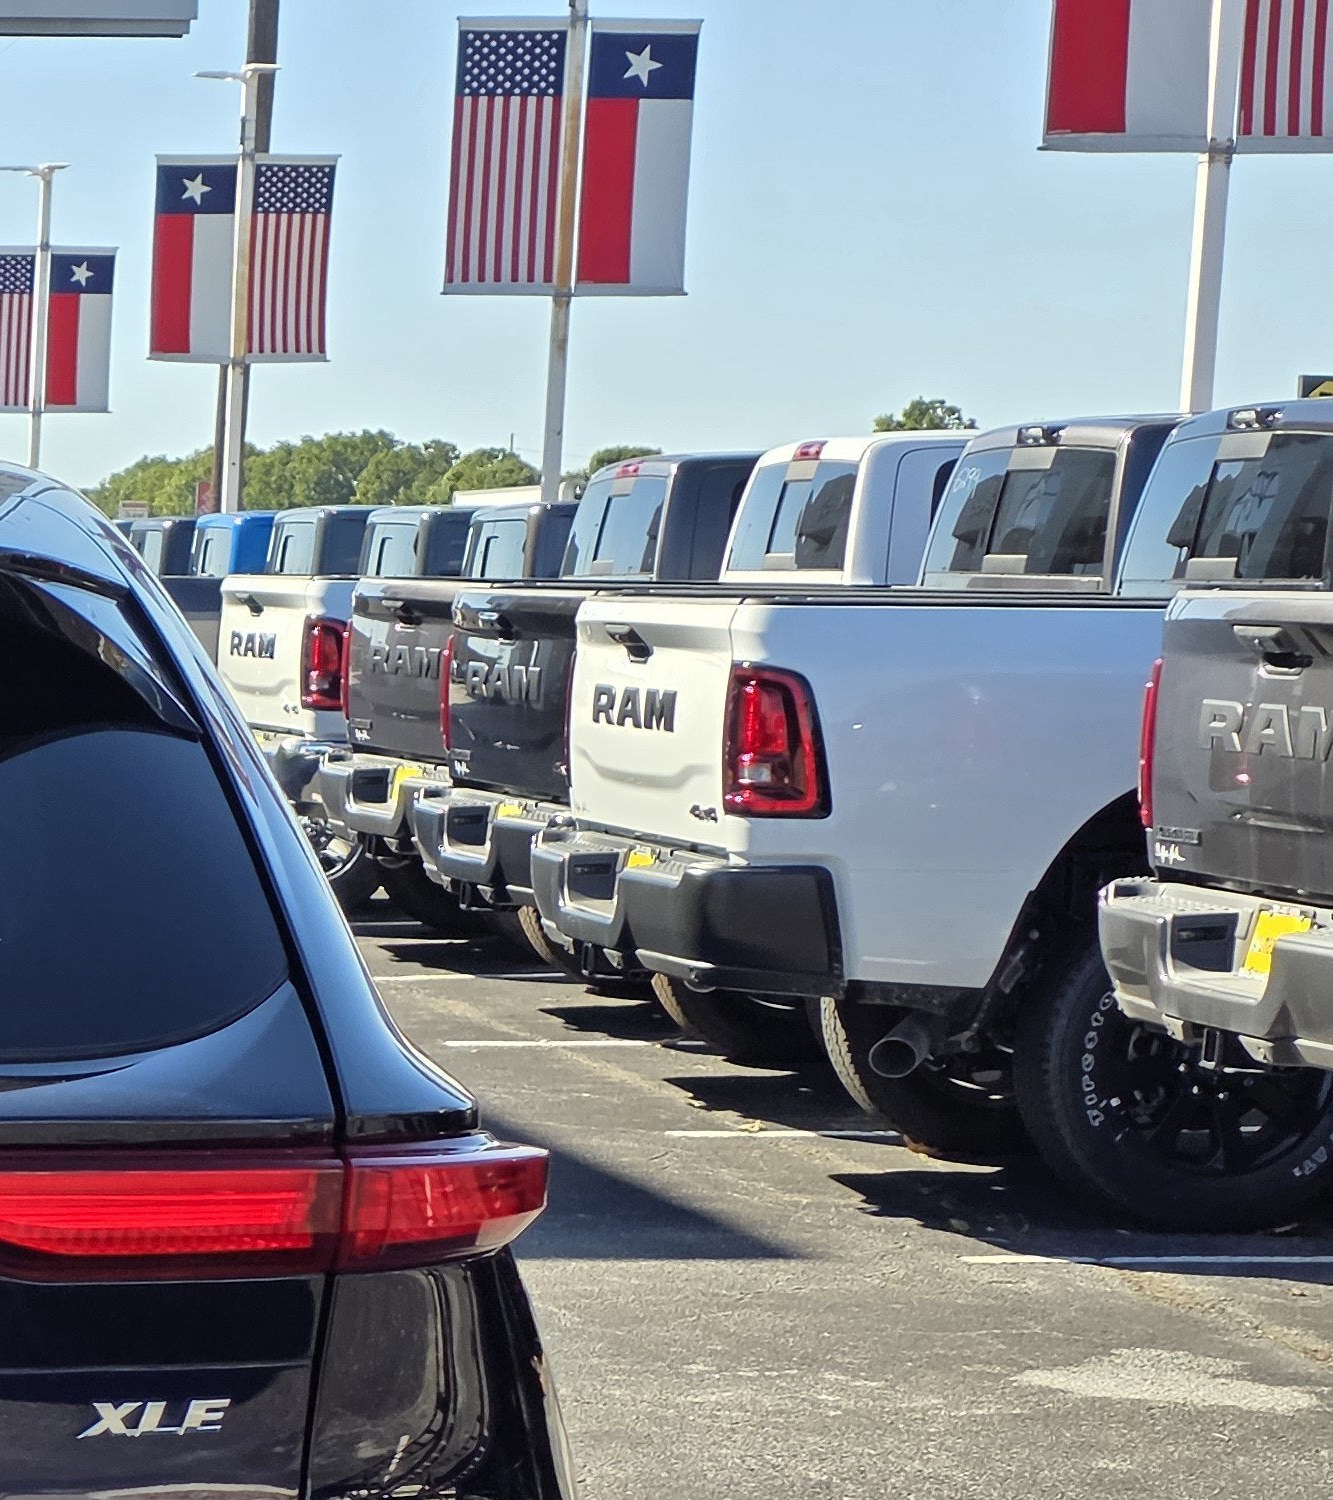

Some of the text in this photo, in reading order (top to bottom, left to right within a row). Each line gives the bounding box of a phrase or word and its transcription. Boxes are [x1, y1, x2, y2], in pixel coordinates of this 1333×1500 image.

[230, 630, 277, 660] RAM
[371, 644, 441, 680] RAM
[465, 660, 544, 708] RAM
[591, 683, 678, 733] RAM
[75, 1398, 232, 1440] XLE
